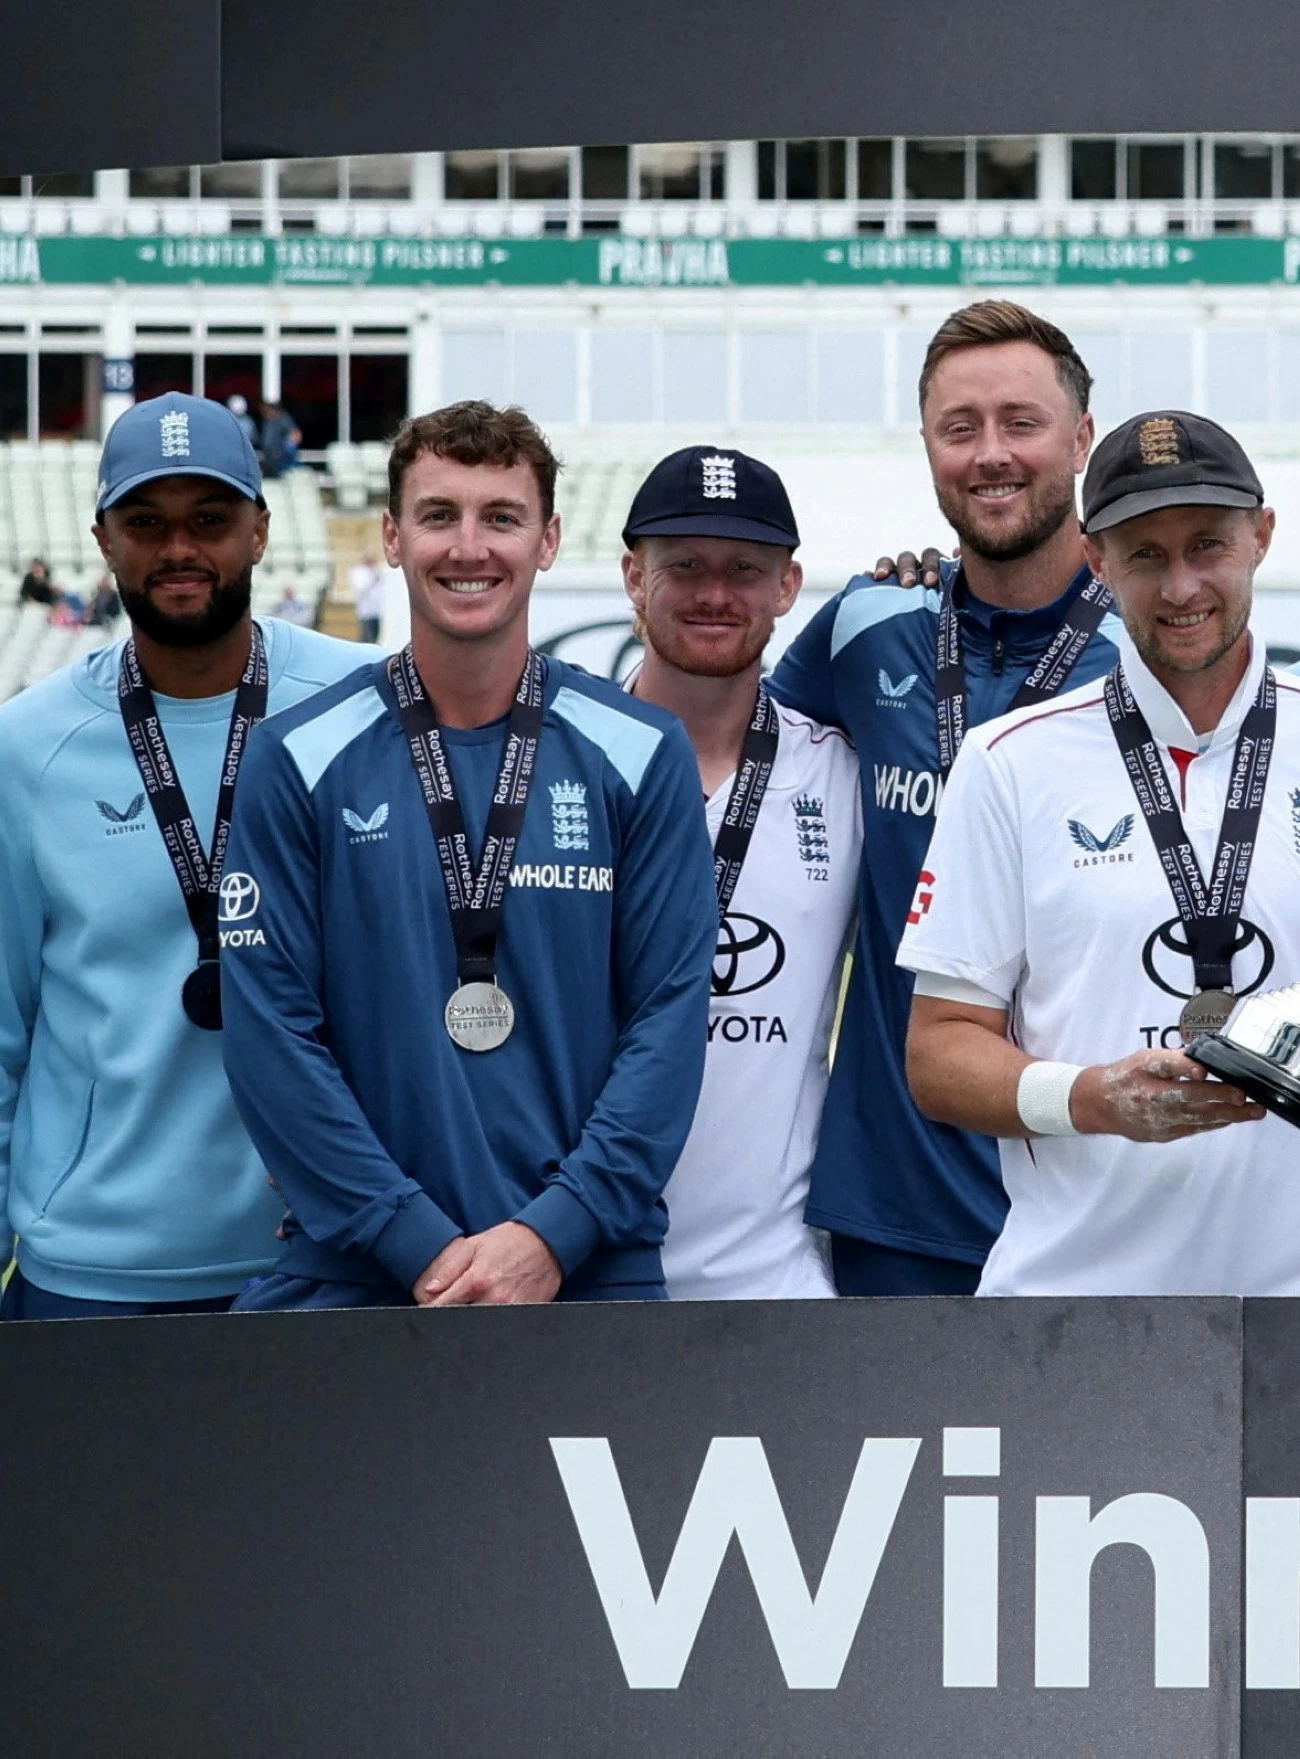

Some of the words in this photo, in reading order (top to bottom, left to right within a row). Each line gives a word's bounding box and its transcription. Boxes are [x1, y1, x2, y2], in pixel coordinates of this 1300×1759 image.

[382, 242, 483, 267] PILSNER
[1067, 242, 1169, 267] PILSNER
[950, 612, 960, 665] thesay
[1025, 623, 1074, 687] Rothesay
[1045, 667, 1066, 692] TEST
[1062, 631, 1089, 667] SERIES
[393, 672, 409, 708] SERIES
[532, 684, 541, 708] TEST
[752, 686, 768, 731] Rothes
[938, 699, 947, 726] TEST
[1105, 684, 1121, 722] SERIES
[1265, 684, 1275, 710] TEST
[145, 716, 175, 787] Rothesay
[223, 715, 248, 786] Rothesay
[940, 729, 950, 767] SERIES
[952, 694, 963, 750] Rothes
[129, 725, 143, 750] TEST
[138, 755, 158, 793] SERIES
[411, 737, 424, 762] TEST
[419, 766, 437, 804] SERIES
[428, 730, 453, 800] Rothesay
[494, 733, 521, 804] Rothesay
[515, 779, 528, 805] TEST
[522, 738, 536, 775] SERIES
[1124, 750, 1140, 775] TEST
[1135, 778, 1155, 816] SERIES
[1141, 741, 1173, 812] Rothesay
[1228, 736, 1255, 809] Rothesay
[1256, 738, 1271, 777] SERIES
[726, 758, 756, 826] Rothesay
[744, 804, 758, 829] TEST
[752, 762, 771, 802] SERIES
[1250, 781, 1264, 809] TEST
[164, 825, 179, 852] TEST
[174, 855, 194, 895] SERIES
[180, 818, 208, 888] Rothesa
[208, 819, 231, 893] Rothesay
[438, 838, 450, 867] TEST
[446, 869, 460, 910] SERIES
[454, 833, 473, 905] Rothes
[471, 835, 500, 909] Rothesay
[491, 881, 505, 908] TEST
[500, 837, 515, 878] SERIES
[509, 865, 575, 889] WHOLE
[723, 861, 740, 899] SERIES
[806, 868, 829, 881] 722
[1074, 853, 1134, 869] CASTORE
[1207, 841, 1235, 917] Rothesay
[1235, 841, 1252, 881] SERIES
[1161, 848, 1177, 876] TEST
[1171, 878, 1192, 921] SERIES
[1230, 886, 1242, 913] TEST
[219, 930, 266, 948] YOTA
[707, 1016, 788, 1043] YOTA
